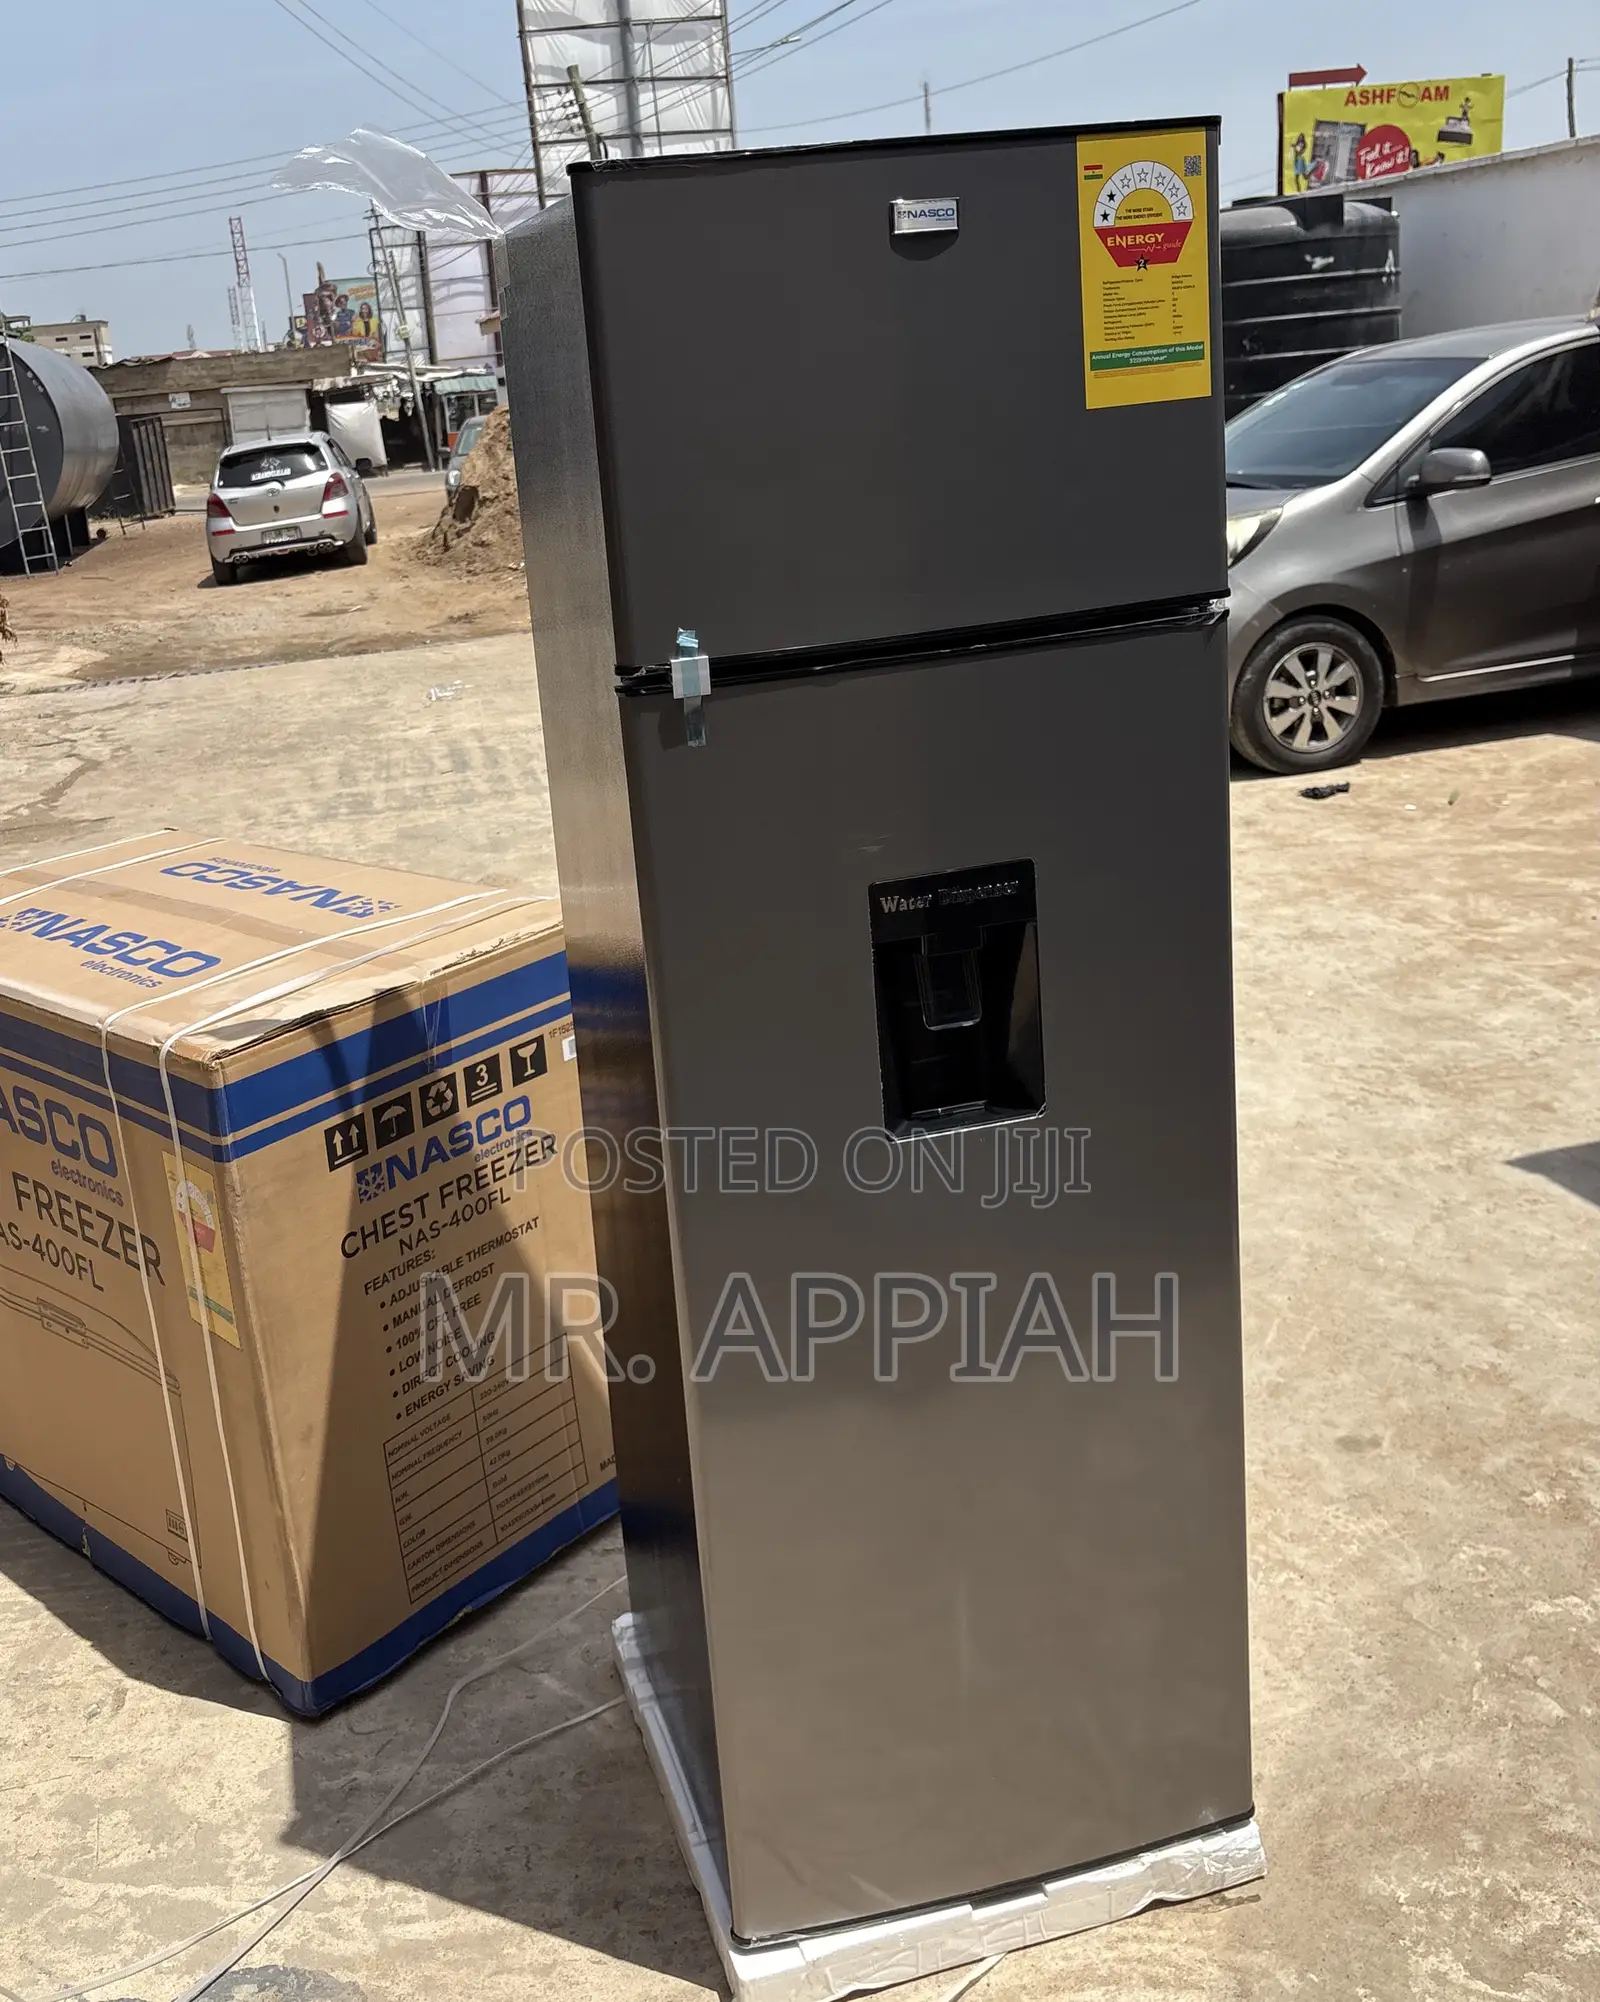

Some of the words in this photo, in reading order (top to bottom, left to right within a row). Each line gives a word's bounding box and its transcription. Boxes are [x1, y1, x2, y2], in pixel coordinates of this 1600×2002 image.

[908, 208, 955, 218] NASCO
[1107, 233, 1165, 248] ENERGY
[1132, 348, 1168, 356] Consumption
[159, 862, 365, 909] NASCO
[880, 894, 933, 914] Water
[938, 880, 1019, 906] Dispenser
[14, 913, 221, 978] NASCO
[80, 959, 163, 988] electronics
[475, 1064, 489, 1086] 3
[386, 1095, 532, 1190] NASCO
[474, 1128, 533, 1163] electronics
[50, 1158, 124, 1208] electronics
[341, 1193, 430, 1259] CHEST
[439, 1133, 558, 1209] FREEZER
[12, 1171, 166, 1286] FREEZER
[399, 1186, 512, 1256] NAS-400FL
[364, 1249, 436, 1296] FEATURES:
[389, 1258, 465, 1307] ADJUSTABLE
[465, 1216, 540, 1263] THERMOSTAT
[392, 1292, 441, 1329] MANUAL
[442, 1262, 495, 1299] DEFROST
[452, 1294, 482, 1318] FREE
[399, 1348, 426, 1373] LOW
[427, 1328, 463, 1356] NOISE
[401, 1364, 442, 1397] DIRECT
[445, 1331, 496, 1368] COOLING
[405, 1381, 452, 1418] ENERGY
[453, 1356, 496, 1388] SAVING
[388, 1434, 419, 1458] NOMINAL
[419, 1413, 452, 1437] VOLTAGE
[391, 1456, 422, 1481] NOMINAL
[422, 1430, 463, 1464] FREQUENCY
[403, 1528, 426, 1549] COLOR
[407, 1545, 435, 1572] CARTON
[435, 1520, 476, 1555] DIMENSIONS
[411, 1567, 443, 1594] PRODUCT
[443, 1540, 484, 1572] DIMENSIONS
